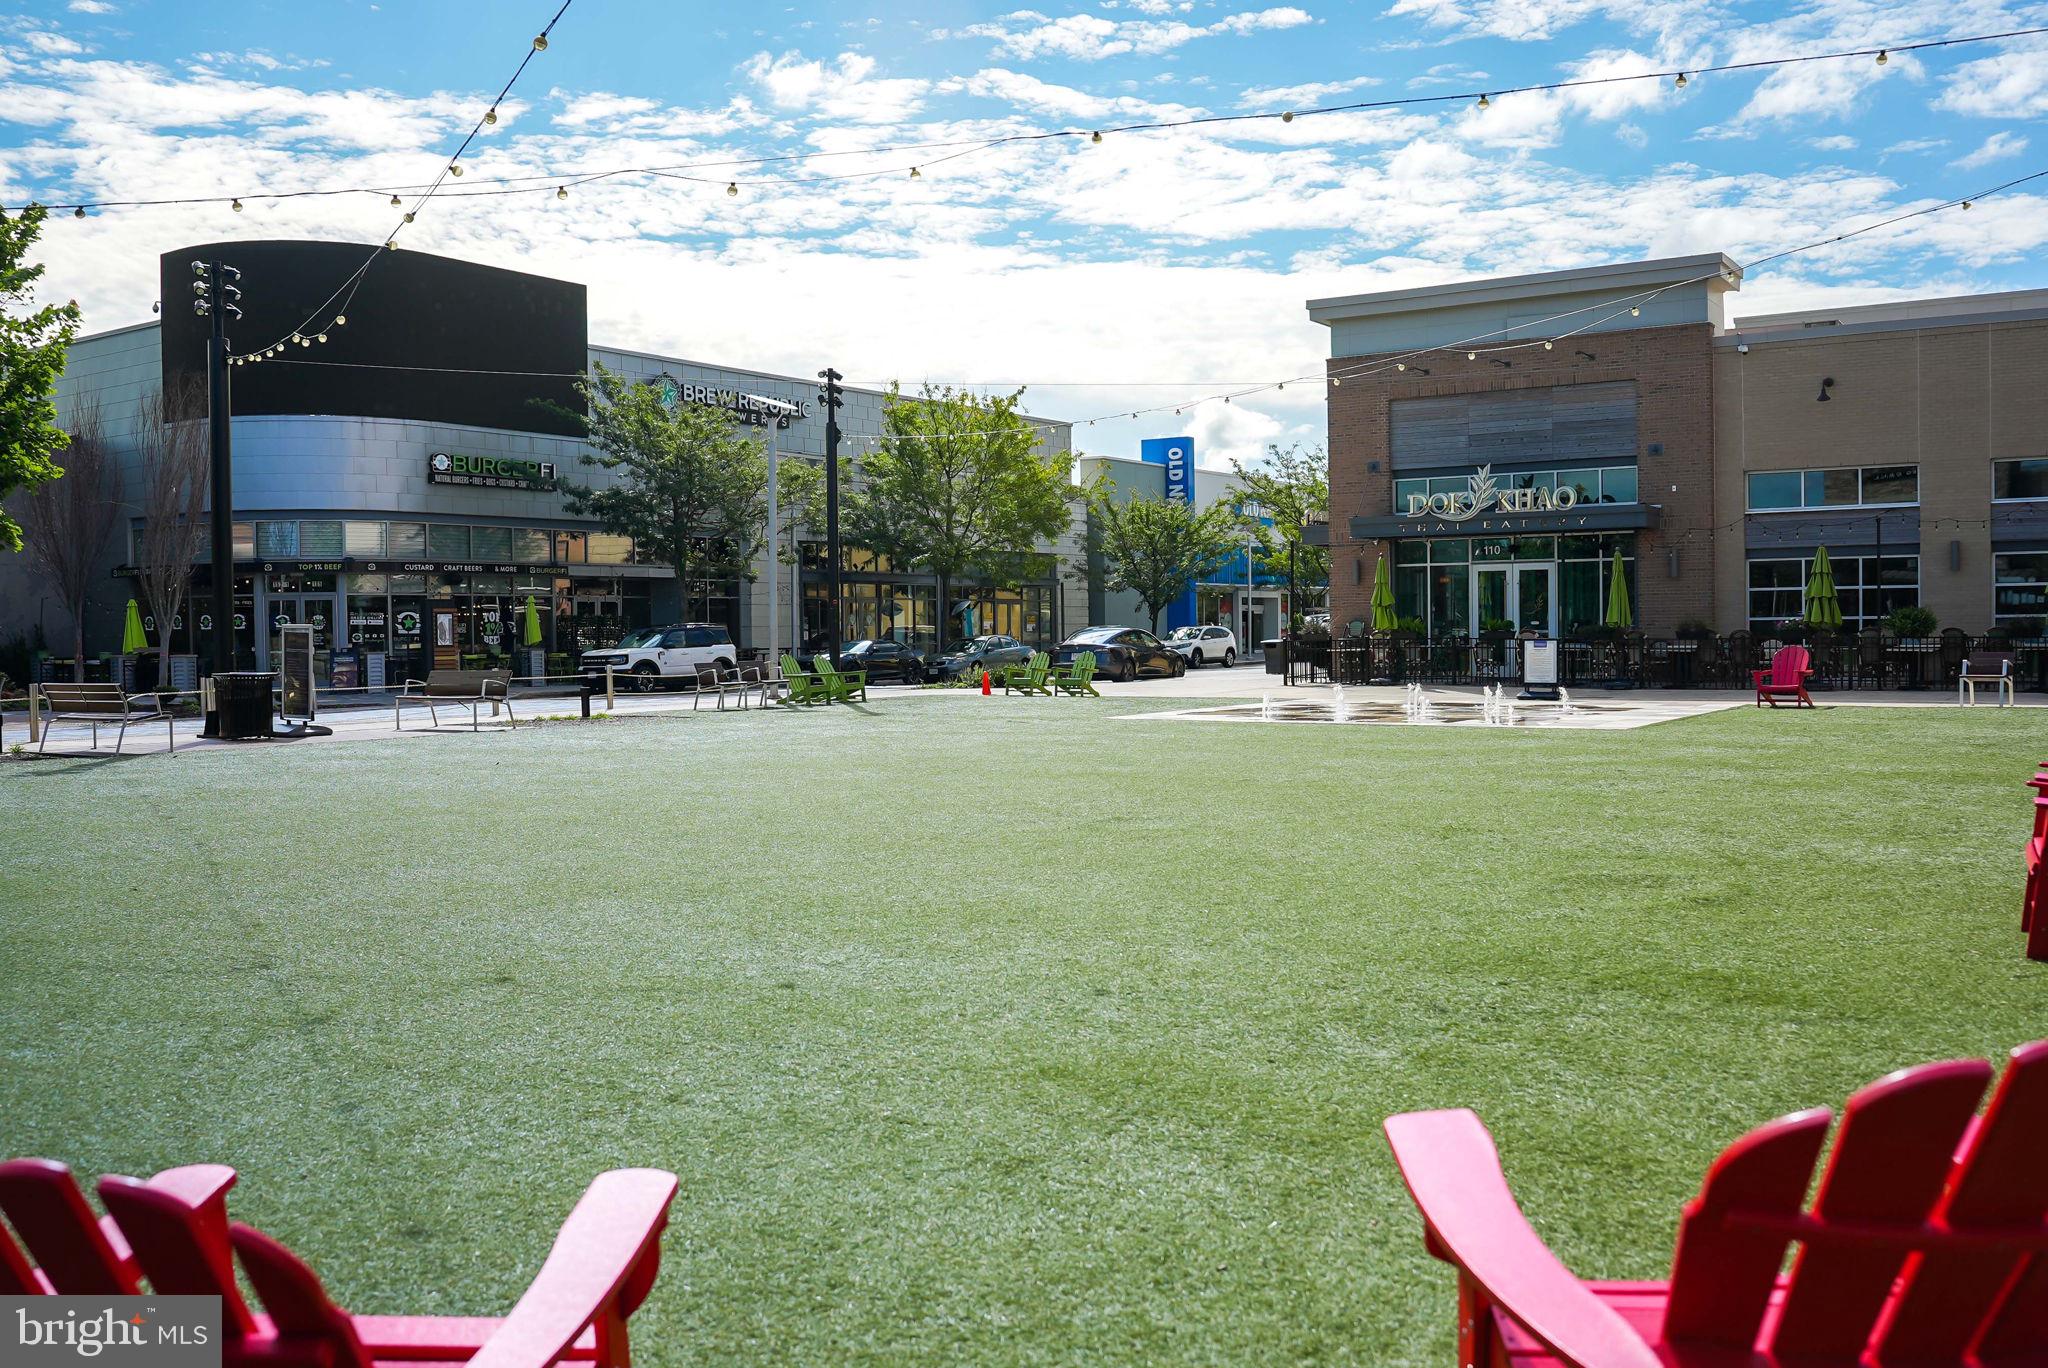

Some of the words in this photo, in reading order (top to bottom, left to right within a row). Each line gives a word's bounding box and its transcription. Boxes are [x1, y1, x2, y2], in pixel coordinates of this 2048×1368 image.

[684, 384, 736, 409] BREW
[738, 392, 812, 418] REPUBLIC
[1168, 447, 1184, 481] OLD
[1407, 492, 1471, 518] DOK
[1495, 485, 1578, 514] KHAO
[1483, 545, 1501, 556] 110
